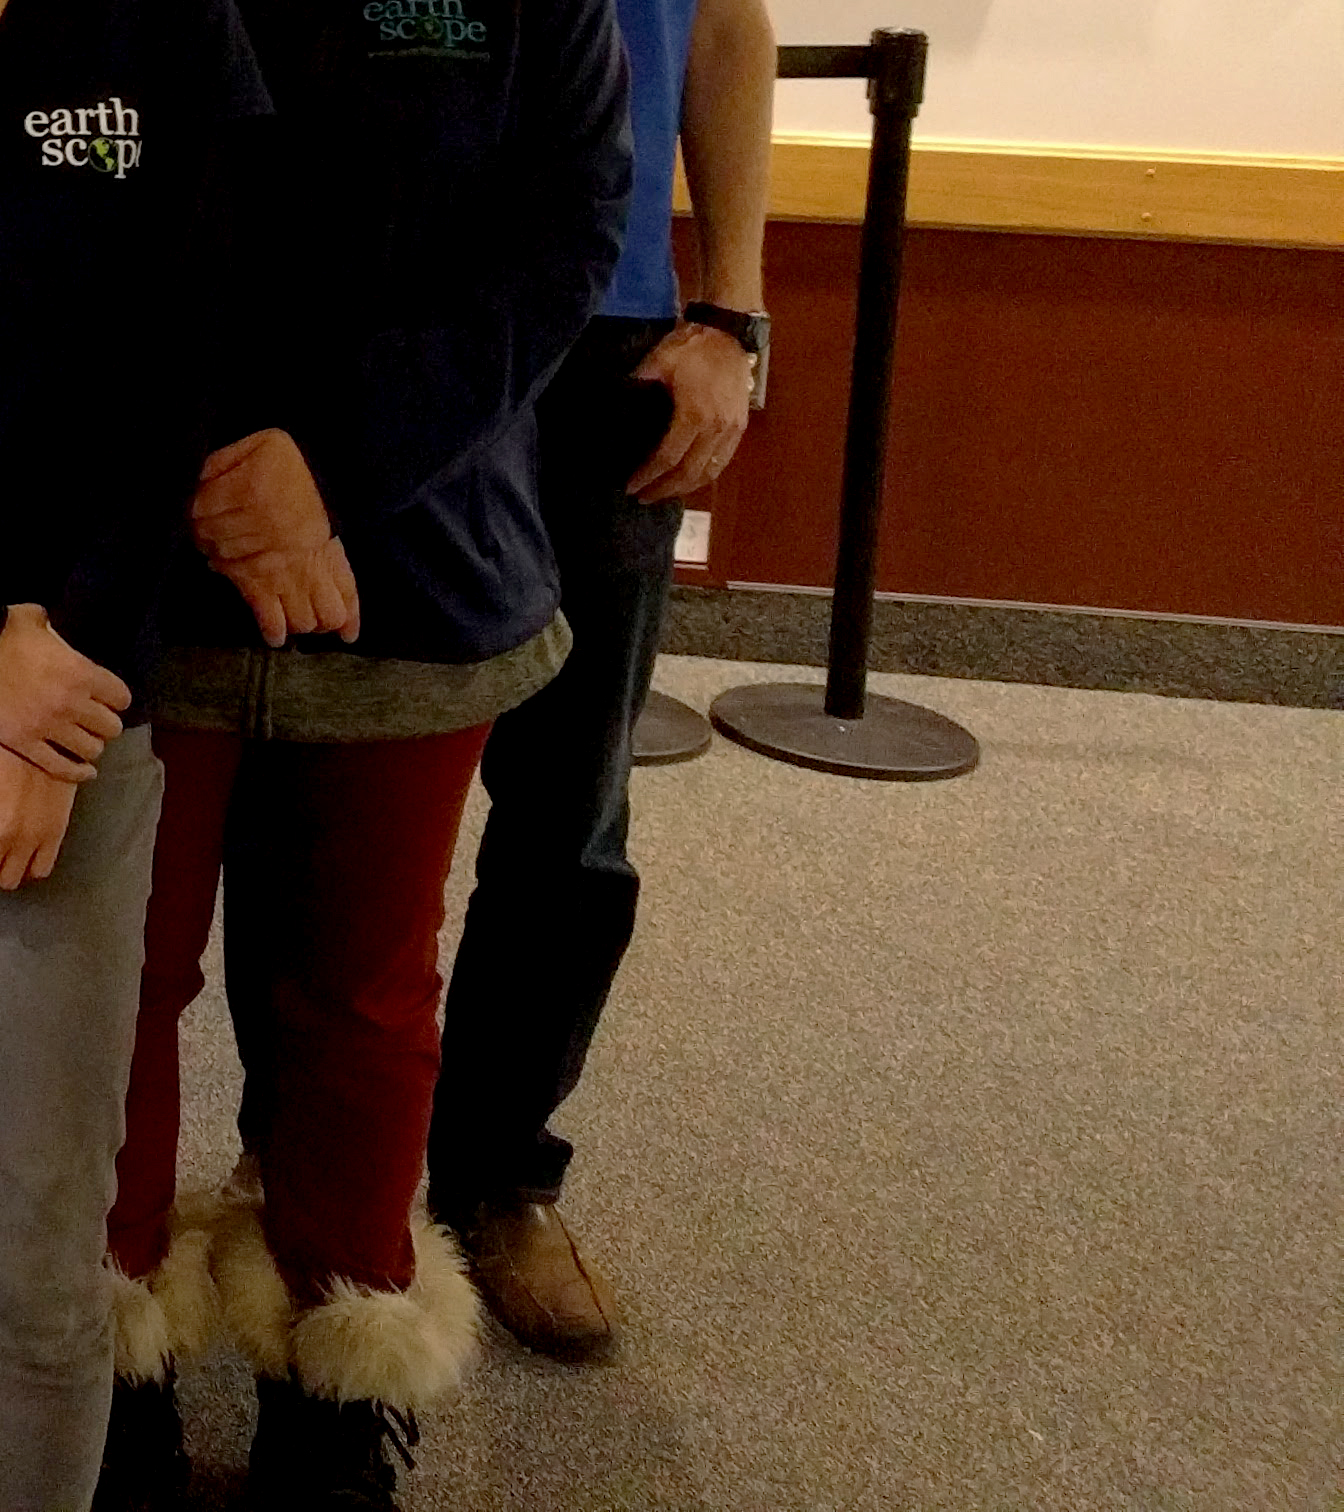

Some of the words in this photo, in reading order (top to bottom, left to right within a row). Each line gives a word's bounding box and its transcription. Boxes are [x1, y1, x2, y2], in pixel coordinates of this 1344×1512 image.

[379, 16, 487, 48] scope
[23, 96, 140, 138] earth
[41, 136, 143, 180] scop
